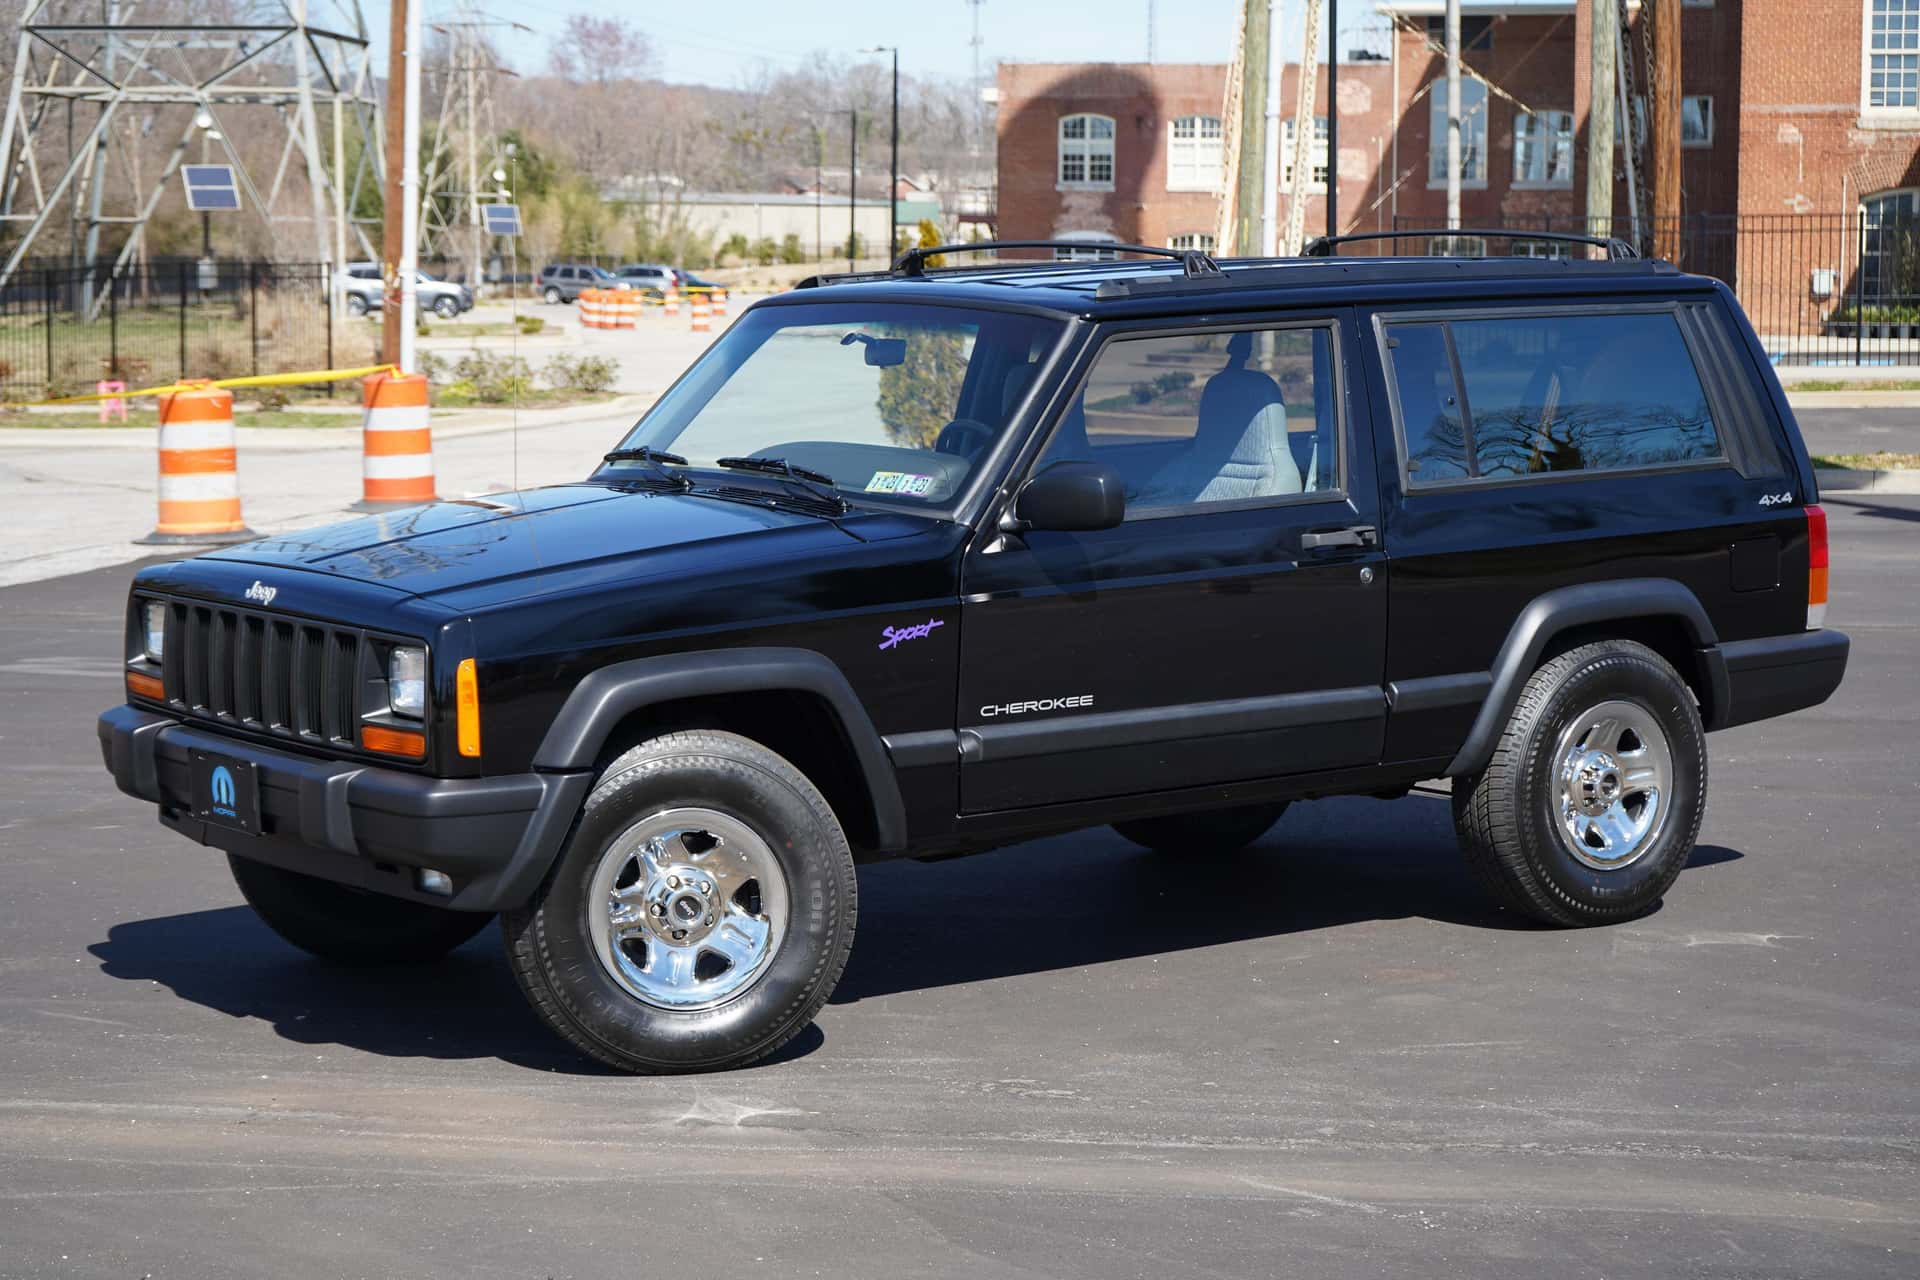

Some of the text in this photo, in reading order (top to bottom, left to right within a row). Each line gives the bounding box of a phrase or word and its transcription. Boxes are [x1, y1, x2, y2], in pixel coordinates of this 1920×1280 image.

[245, 580, 277, 606] Jeep
[878, 618, 945, 651] Sport
[980, 695, 1094, 717] CHEROKEE
